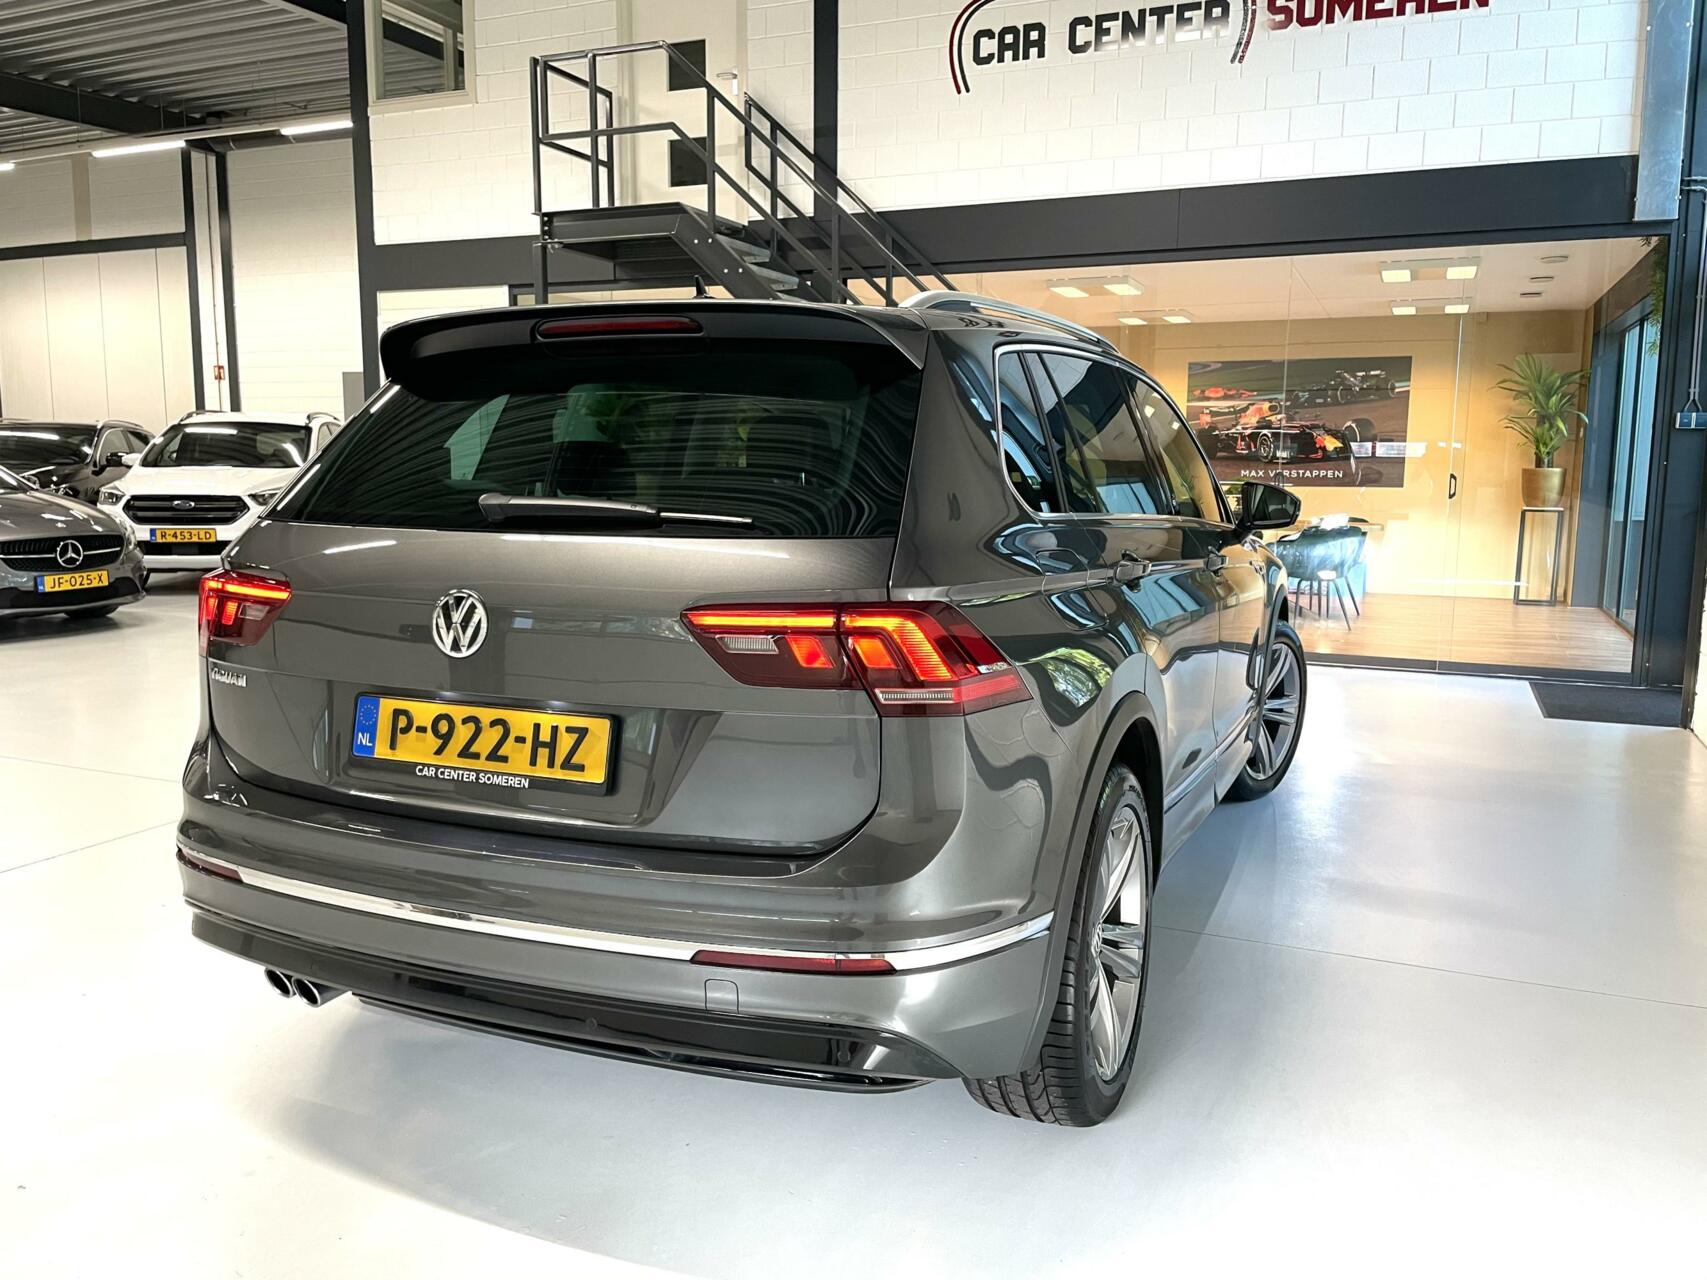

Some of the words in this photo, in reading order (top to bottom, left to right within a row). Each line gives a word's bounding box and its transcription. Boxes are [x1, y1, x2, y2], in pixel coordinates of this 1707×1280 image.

[972, 21, 1047, 66] CAR
[1067, 0, 1231, 54] CENTER
[1240, 469, 1265, 478] MAX
[1268, 469, 1344, 478] VRSTAPPEN
[160, 530, 212, 541] R-453-LD
[50, 573, 104, 589] JF-025-X
[357, 732, 373, 747] NL
[388, 707, 589, 773] P-922-HZ
[415, 765, 436, 779] CAR
[437, 767, 477, 783] CENTER
[478, 773, 529, 789] SOMEREN
